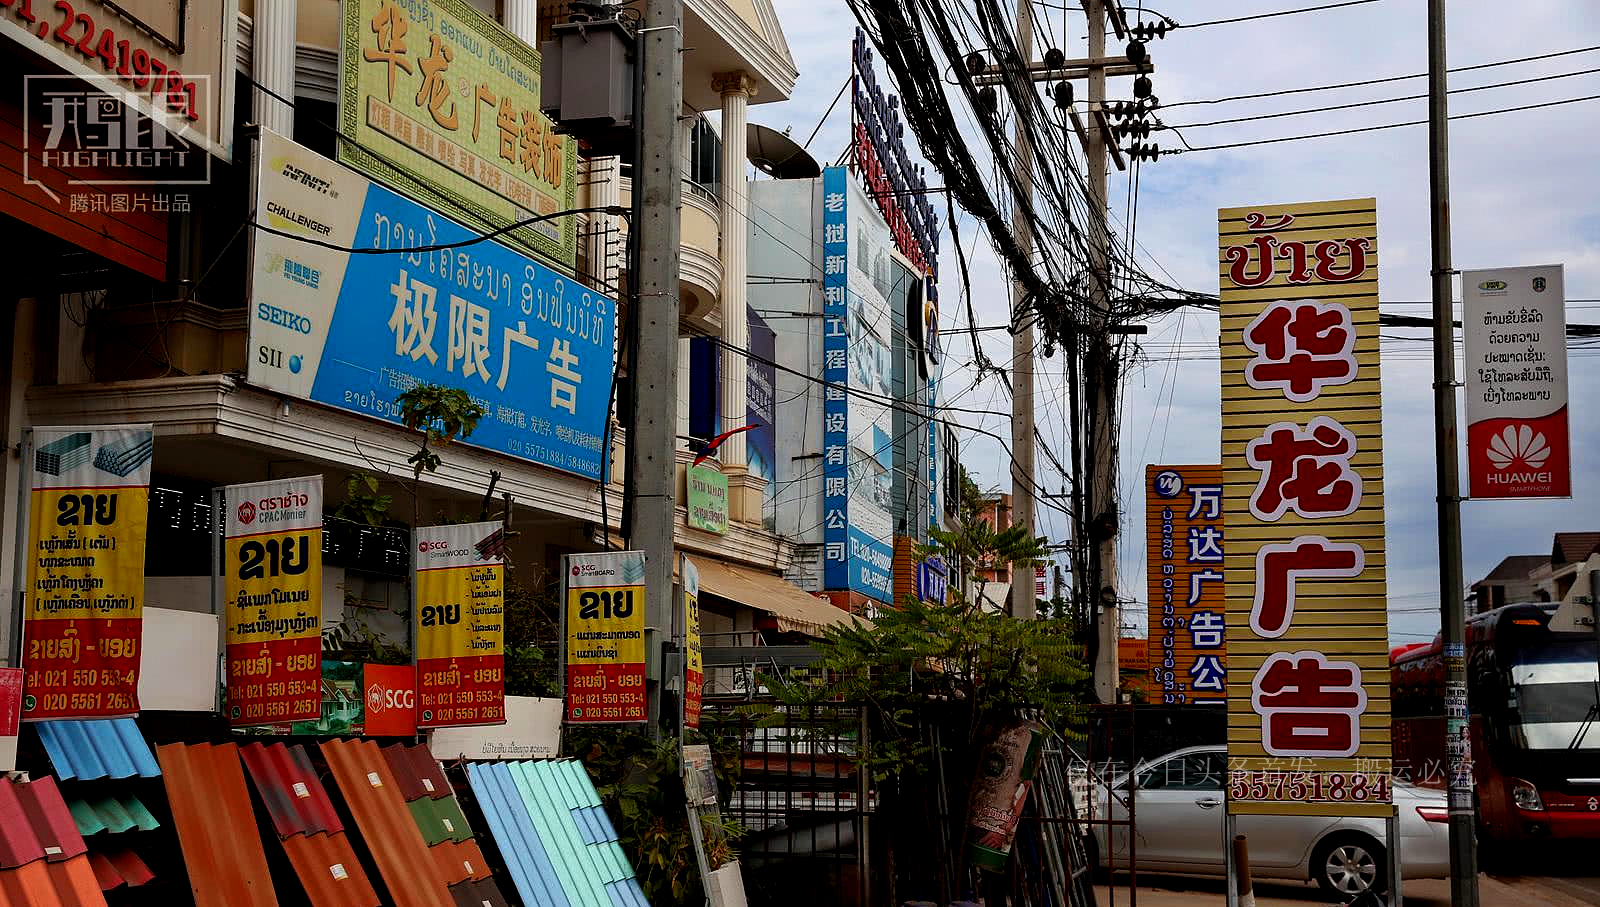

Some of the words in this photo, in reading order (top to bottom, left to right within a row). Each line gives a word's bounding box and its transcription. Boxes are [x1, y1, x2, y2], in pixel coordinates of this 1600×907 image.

[472, 81, 563, 190] 广告装饰
[266, 201, 332, 237] CHALLENGER
[1226, 212, 1370, 287] ປ້າຍ
[257, 302, 312, 335] SEIKO
[387, 268, 583, 417] 极限广告
[258, 345, 283, 369] SII
[825, 192, 847, 564] 老挝新利工程建设有限公司
[525, 442, 602, 475] 55751884/5848682
[1487, 472, 1552, 484] HUAWEI
[57, 494, 118, 526] ຂາຍ
[259, 491, 309, 511] ตราช้าง
[1243, 300, 1368, 757] 华龙广告
[429, 541, 448, 550] SCG
[239, 536, 309, 580] ຂາຍ
[579, 590, 634, 620] ຂາຍ
[1188, 487, 1226, 704] 万达广告公
[421, 604, 460, 627] ຂາຍ
[44, 670, 67, 687] 021
[73, 670, 97, 686] 550
[230, 686, 244, 700] Tel:
[246, 684, 263, 699] 021
[266, 682, 285, 697] 550
[288, 680, 317, 695] 553-4
[43, 694, 67, 710] 020
[71, 694, 101, 709] 5561
[106, 693, 135, 709] 2651
[246, 704, 264, 718] 020
[266, 702, 290, 716] 5561
[294, 699, 317, 714] 2651
[385, 689, 414, 709] SCG
[422, 693, 435, 705] Tel:
[437, 692, 453, 705] 021
[456, 691, 473, 703] 550
[476, 689, 502, 702] 553-4
[571, 694, 584, 704] Tel:
[586, 693, 600, 704] 021
[603, 693, 617, 704] 550
[620, 692, 643, 704] 553-4
[437, 708, 453, 721] 020
[456, 707, 478, 719] 5561
[481, 705, 503, 718] 2651
[586, 709, 600, 718] 020
[603, 708, 622, 718] 5561
[625, 707, 645, 717] 2651
[1231, 771, 1392, 803] 55751884
